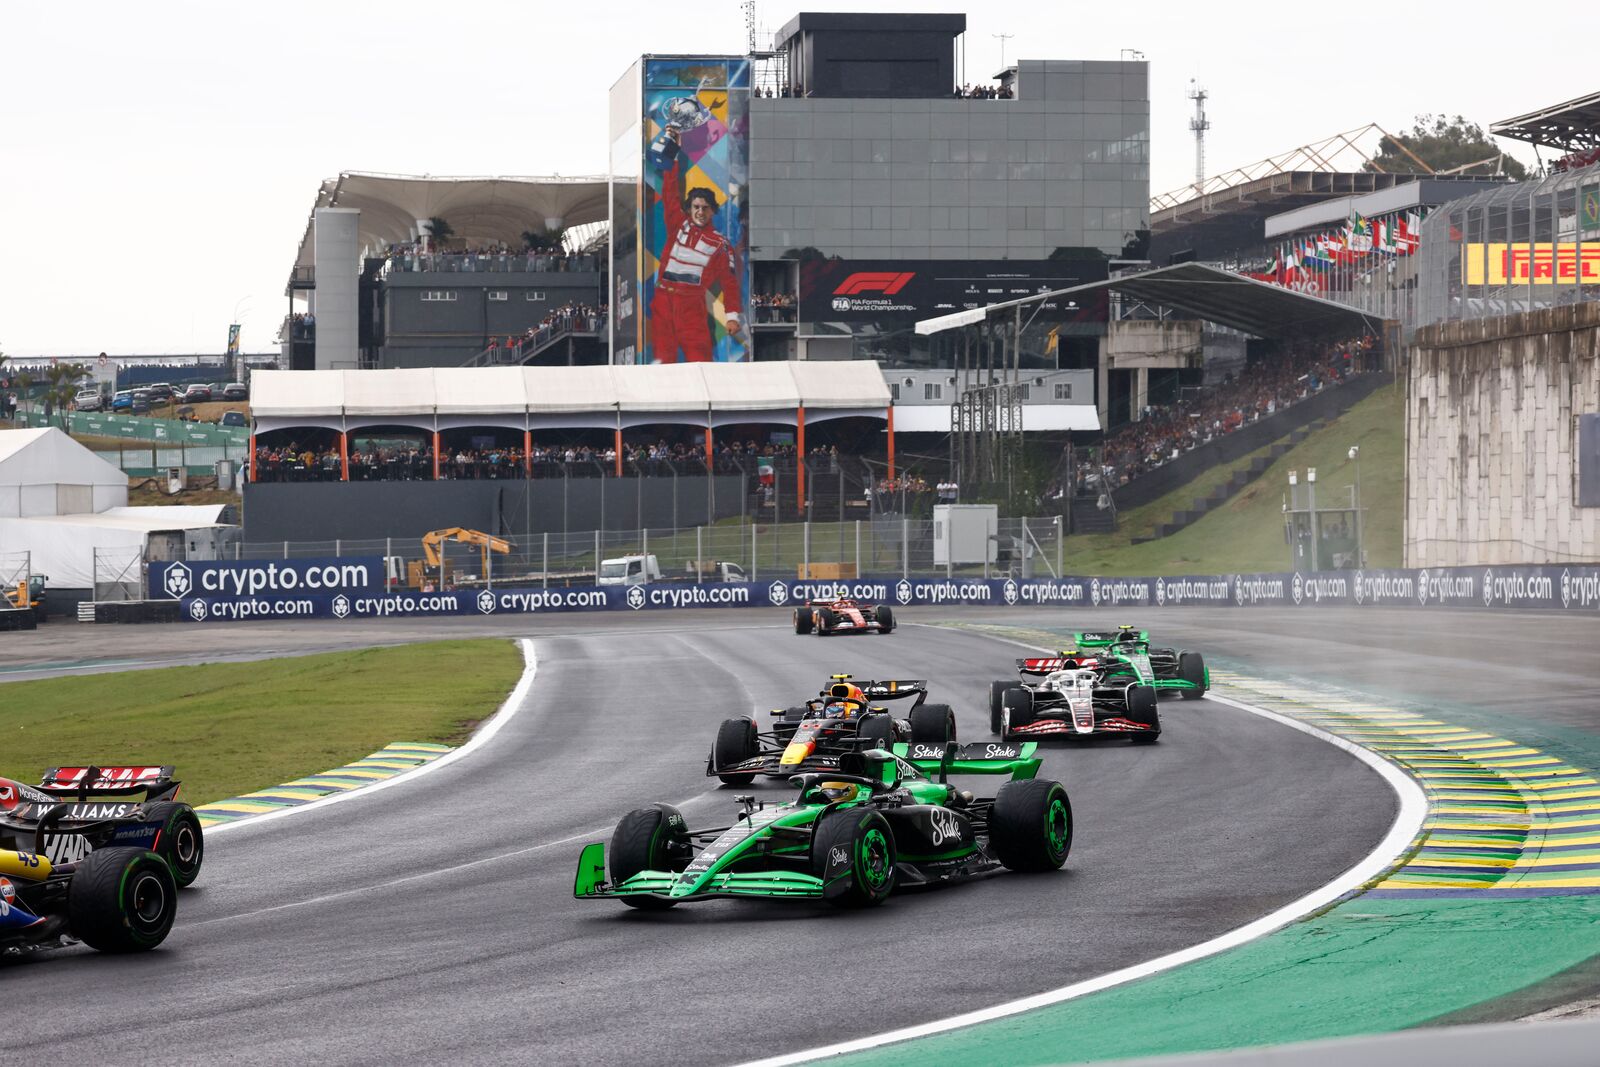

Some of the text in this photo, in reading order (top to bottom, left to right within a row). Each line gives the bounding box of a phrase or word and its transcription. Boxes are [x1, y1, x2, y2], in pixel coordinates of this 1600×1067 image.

[202, 563, 368, 595] crypto.com
[1364, 573, 1413, 602] crypto.com
[1494, 571, 1552, 604] crypto.com
[1571, 572, 1600, 606] crypt
[501, 589, 607, 611] crypto.com
[651, 585, 749, 607] crypto.com
[915, 581, 990, 603] crypto.com
[1021, 582, 1083, 604] crypto.com
[1101, 582, 1149, 604] crypto.com
[1243, 577, 1284, 604] crypto.com
[212, 598, 313, 619] crypto.com
[355, 595, 458, 615] crypto.com
[913, 744, 944, 759] Stake
[985, 744, 1016, 758] Stake
[896, 757, 917, 780] Stake
[37, 804, 127, 820] WLIAMS
[115, 827, 156, 840] KOMATSU
[930, 807, 963, 847] Stake
[18, 851, 40, 868] 43
[832, 848, 848, 867] Stake
[2, 886, 15, 896] Gulf
